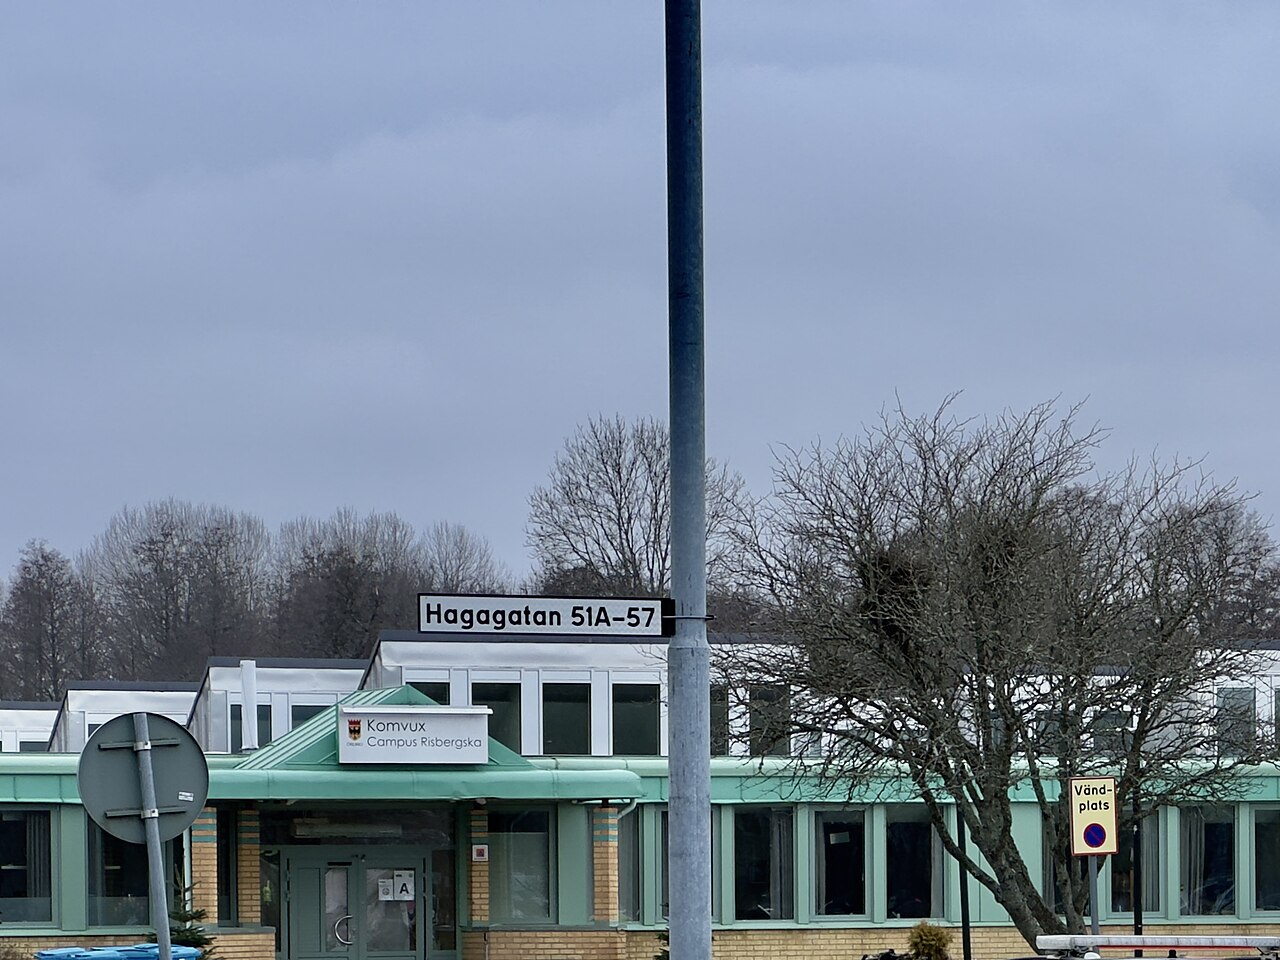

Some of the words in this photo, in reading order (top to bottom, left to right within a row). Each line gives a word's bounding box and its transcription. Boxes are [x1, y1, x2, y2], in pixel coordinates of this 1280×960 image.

[426, 603, 561, 630] Hagagatan
[571, 606, 655, 628] 51A-57
[367, 719, 426, 732] Komvux
[367, 736, 418, 749] Campus
[420, 737, 482, 749] Risbergska
[1074, 784, 1112, 796] Vänd-
[1079, 800, 1109, 813] plats
[399, 882, 409, 894] A
